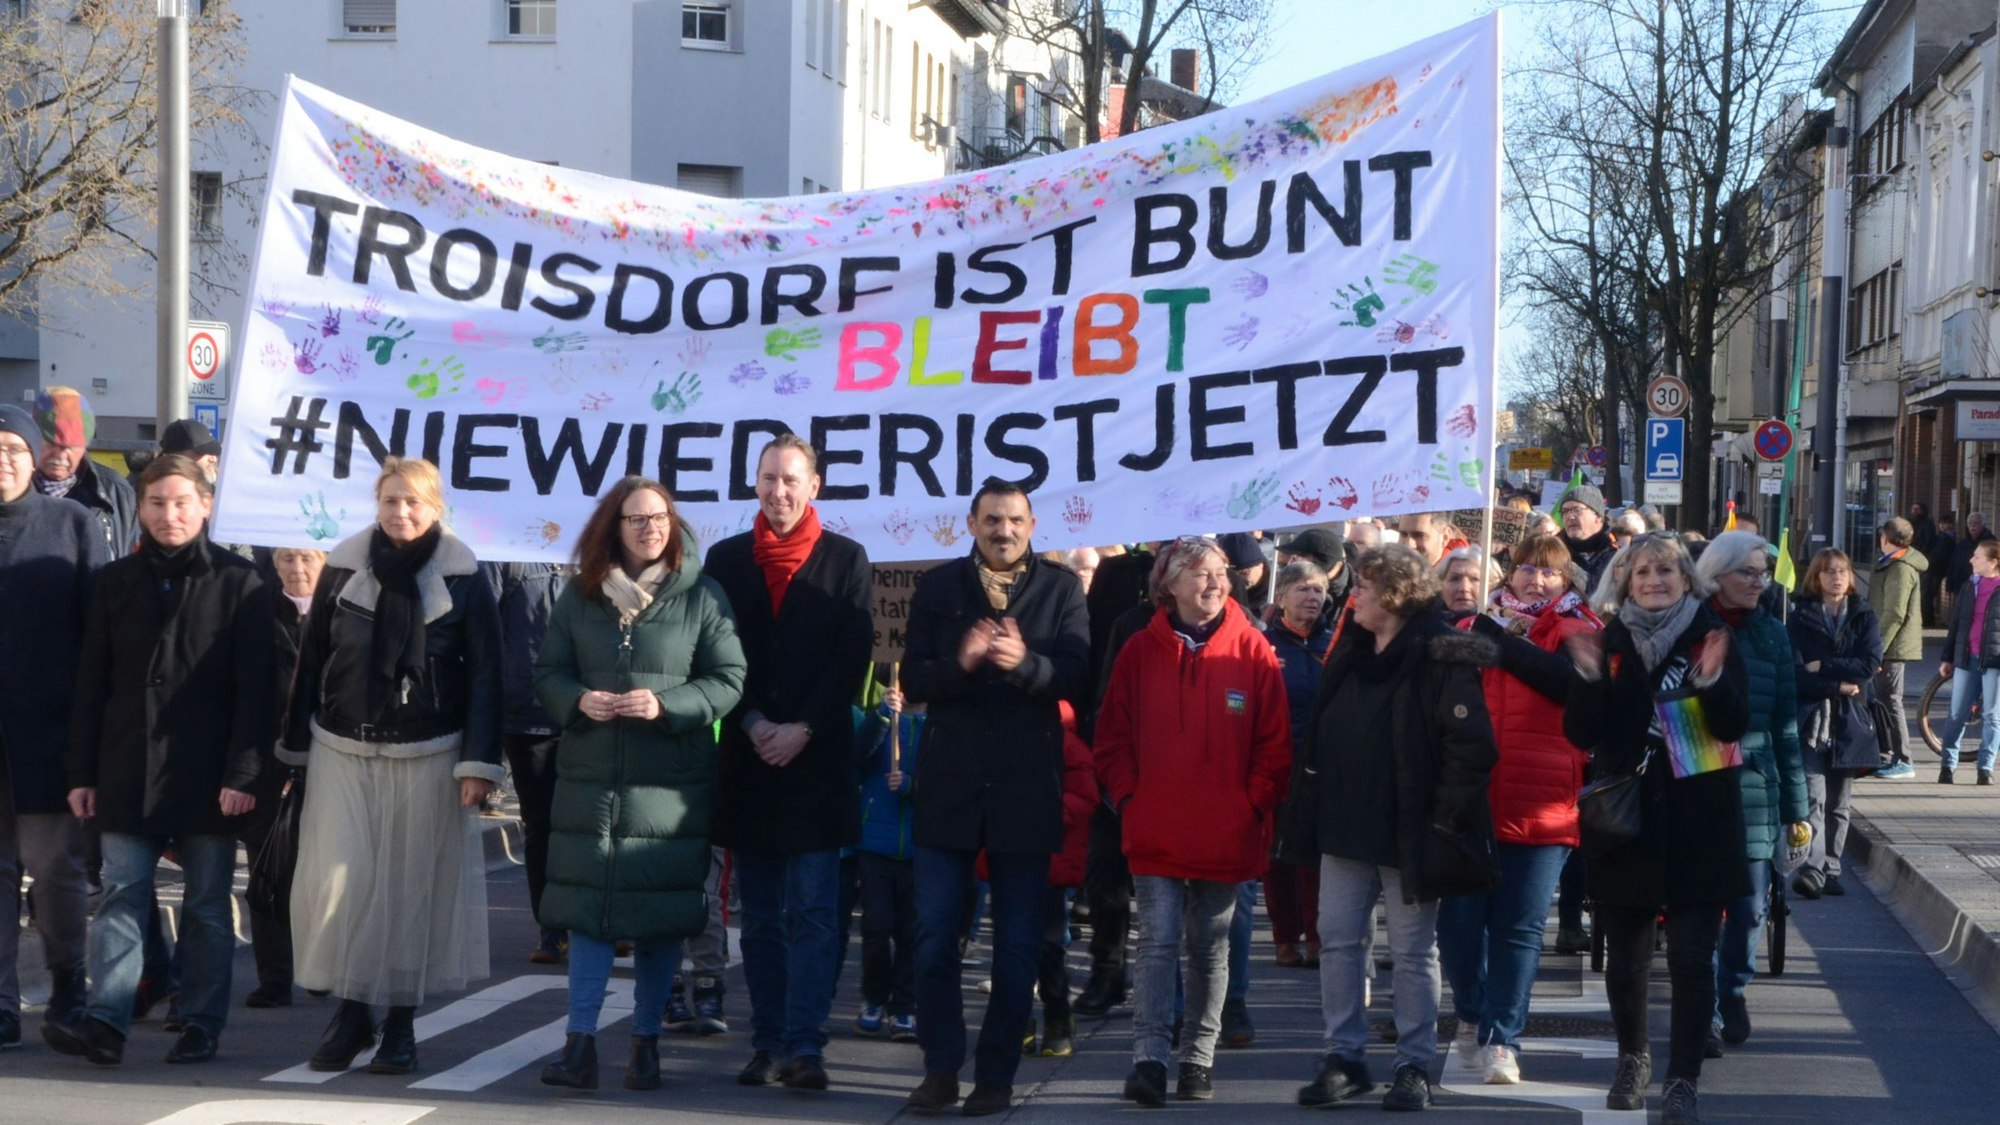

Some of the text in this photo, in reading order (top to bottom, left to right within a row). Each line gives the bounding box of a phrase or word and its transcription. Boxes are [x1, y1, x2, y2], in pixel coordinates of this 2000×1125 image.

[292, 150, 1432, 335] TROISDORF IST BUNT
[834, 287, 1210, 392] BLEIBT
[193, 345, 213, 366] 30
[191, 382, 216, 395] ZONE
[1656, 387, 1680, 407] 30
[1652, 422, 1668, 447] P
[1493, 511, 1524, 523] STOP
